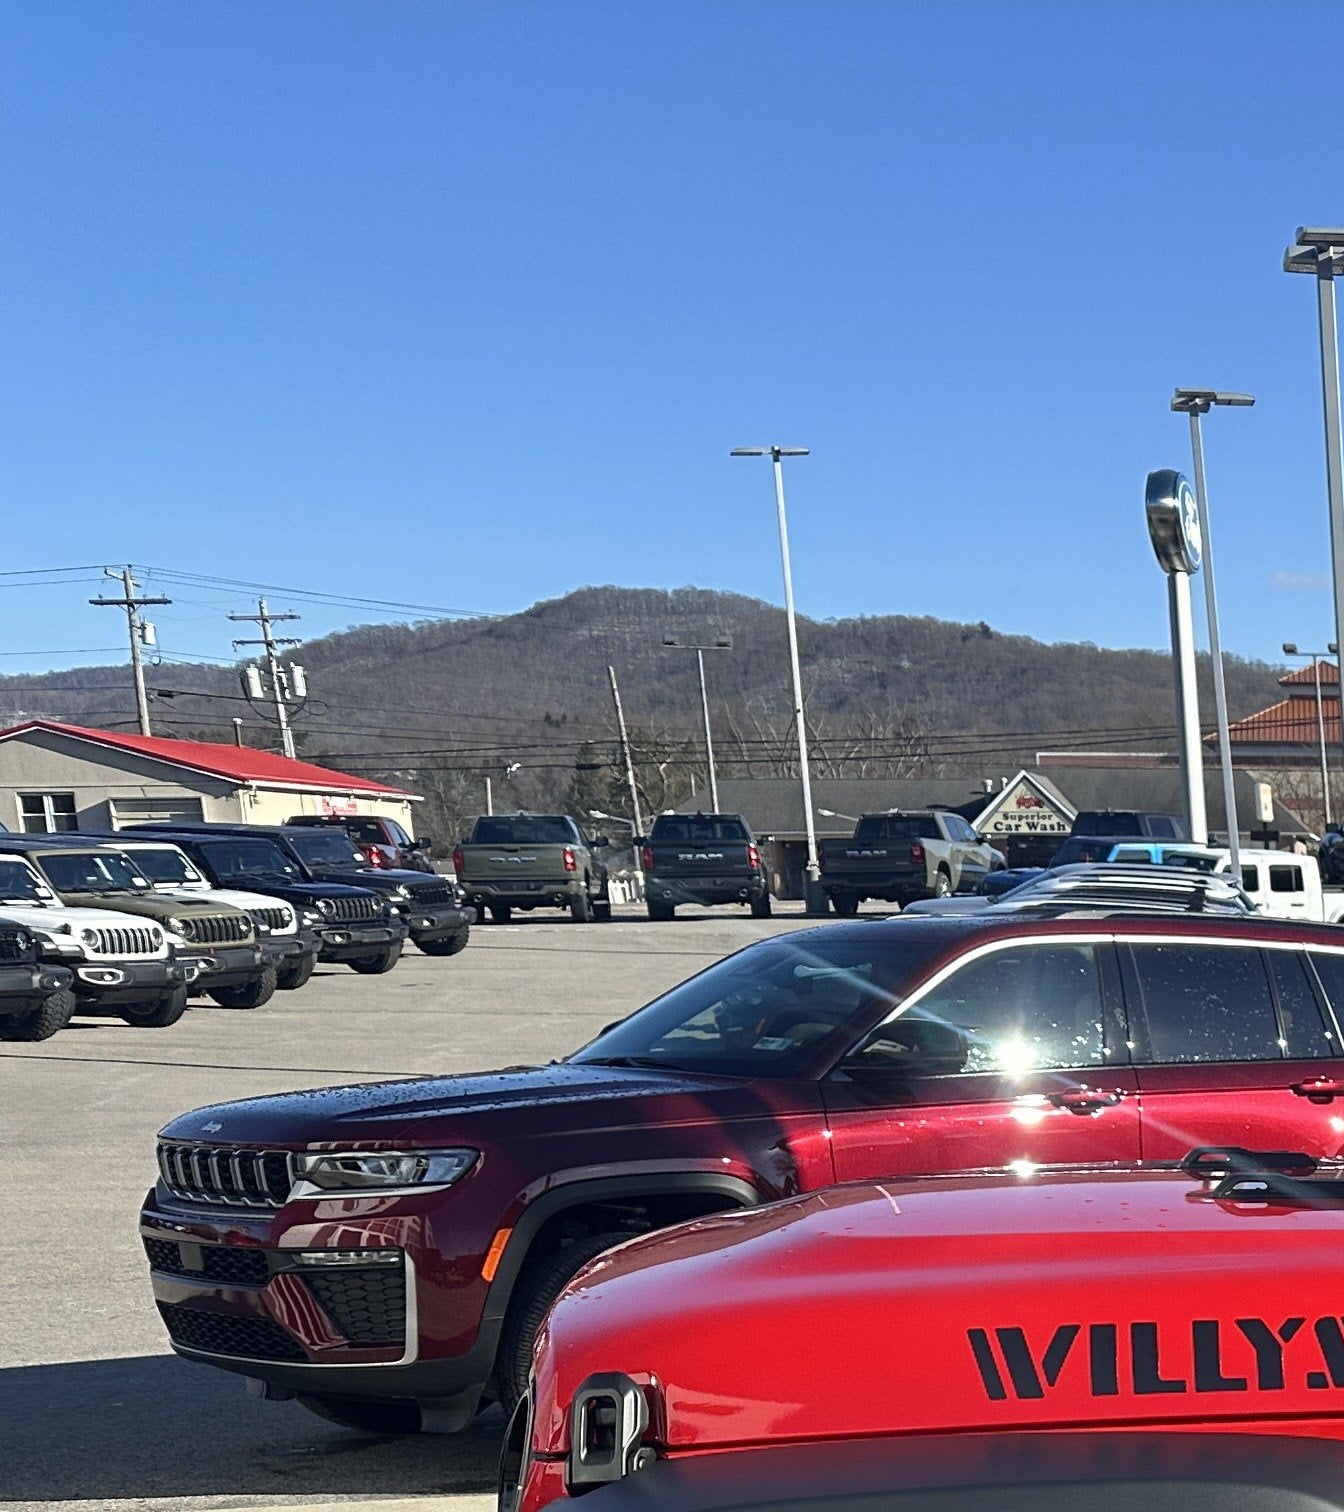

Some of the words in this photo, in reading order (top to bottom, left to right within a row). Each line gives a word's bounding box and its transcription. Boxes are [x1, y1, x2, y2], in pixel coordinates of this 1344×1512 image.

[1002, 812, 1053, 821] Superior
[993, 821, 1021, 831] Car
[1026, 821, 1067, 831] Wash
[677, 853, 723, 862] RAM
